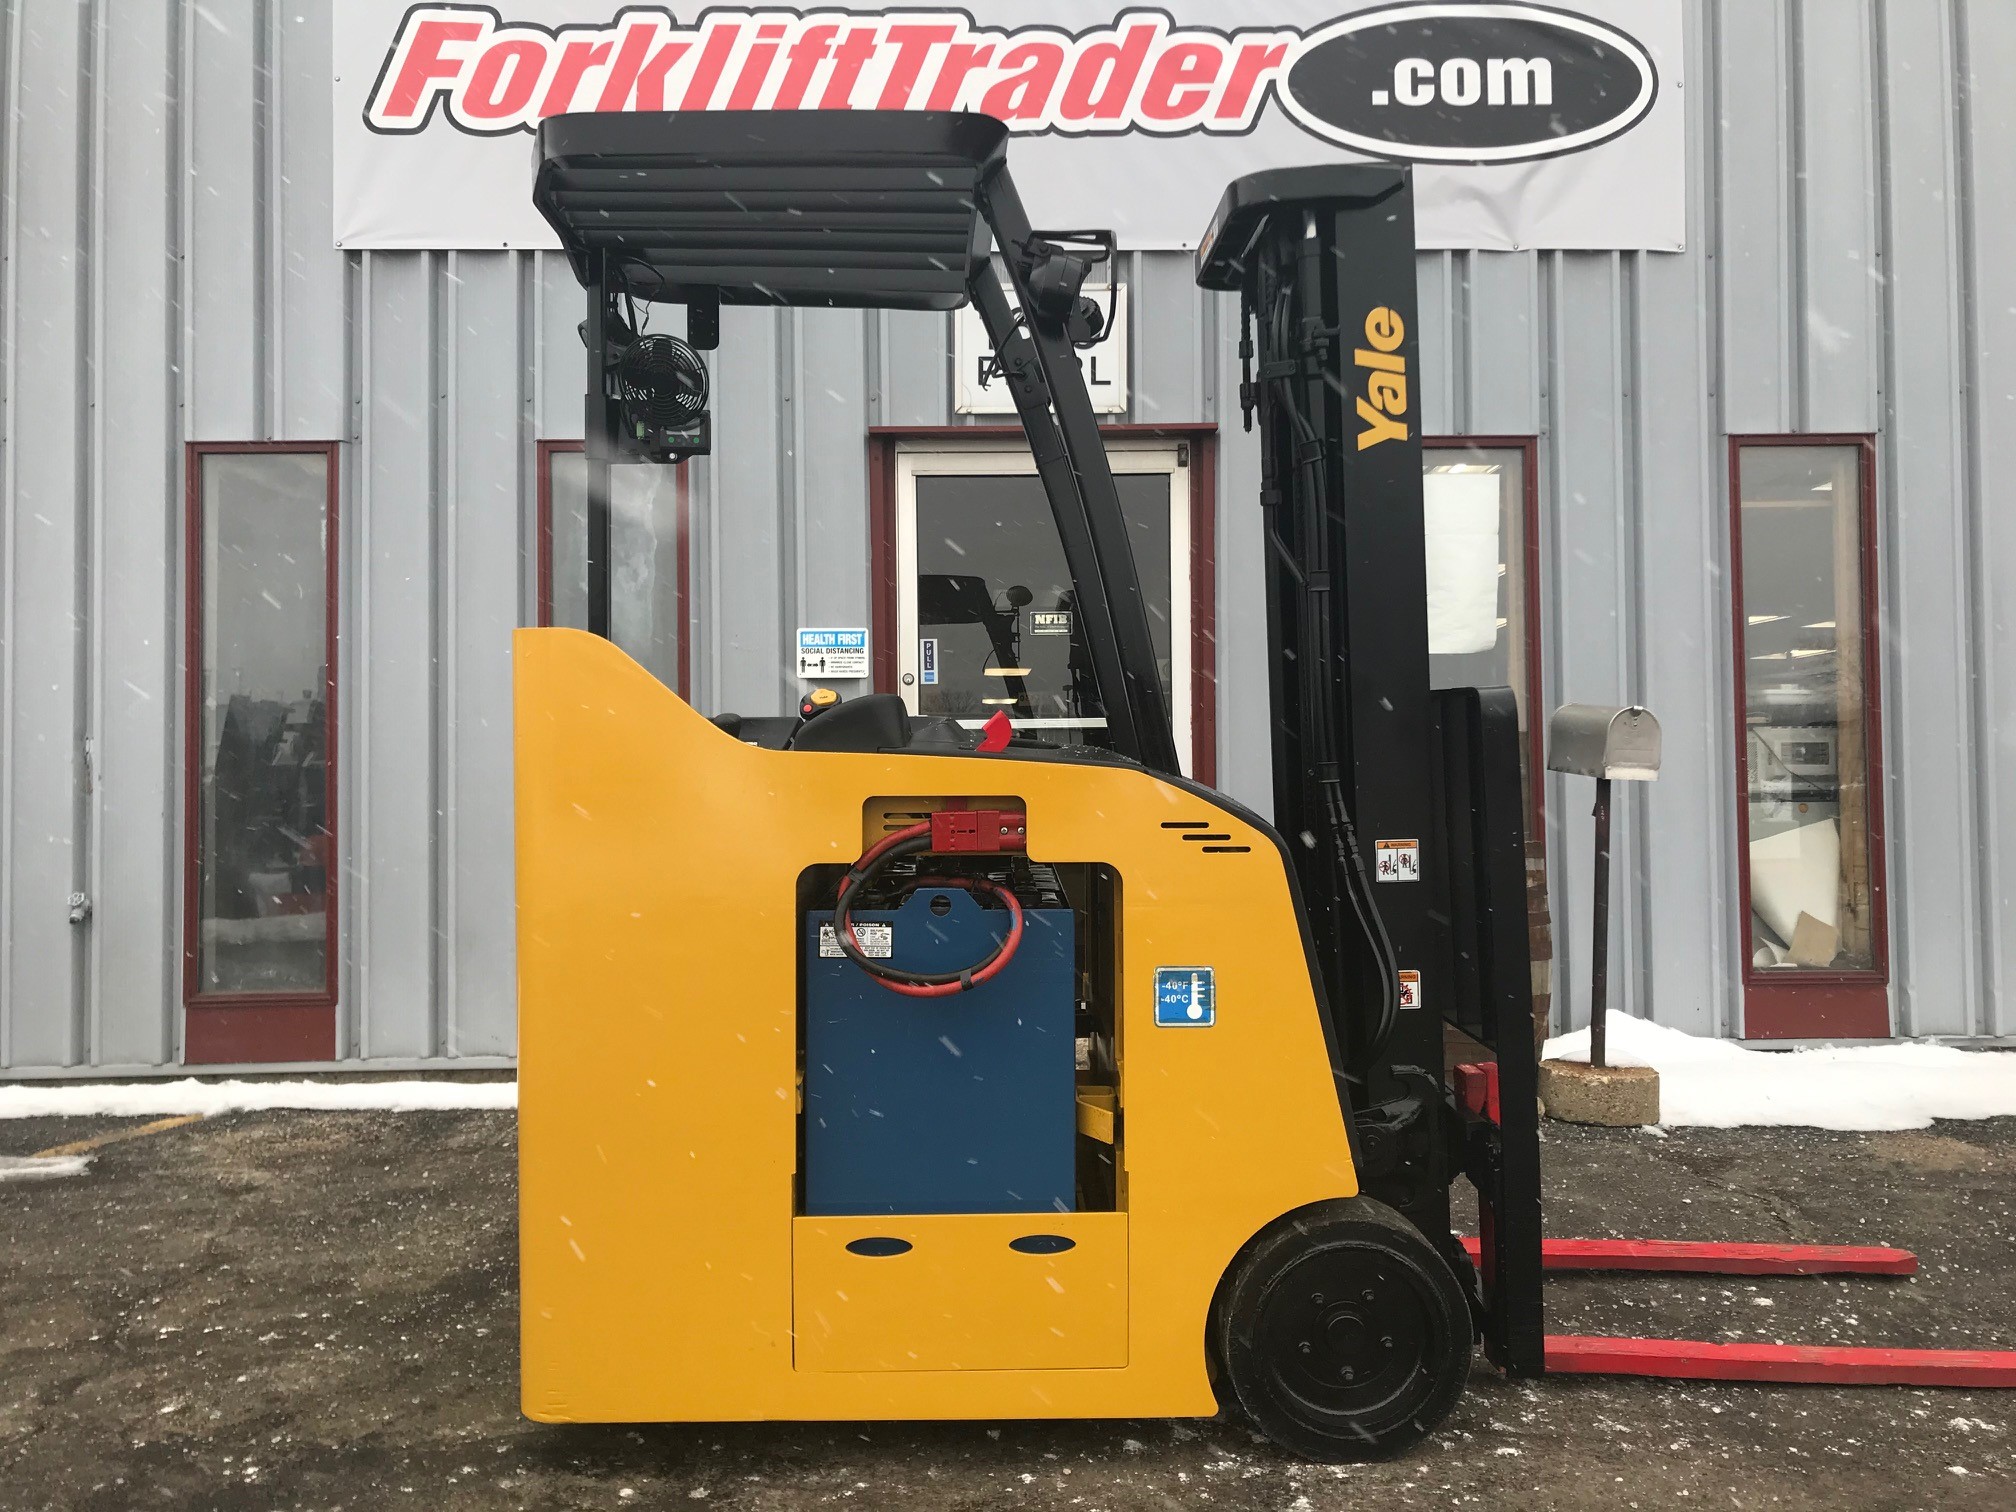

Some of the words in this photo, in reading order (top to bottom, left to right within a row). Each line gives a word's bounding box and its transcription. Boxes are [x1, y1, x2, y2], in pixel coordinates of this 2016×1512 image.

[1353, 305, 1409, 452] Yale
[1034, 613, 1067, 625] NFIB
[802, 633, 835, 645] HEALTH
[837, 633, 862, 645] FIRST
[1160, 994, 1189, 1004] -40°C
